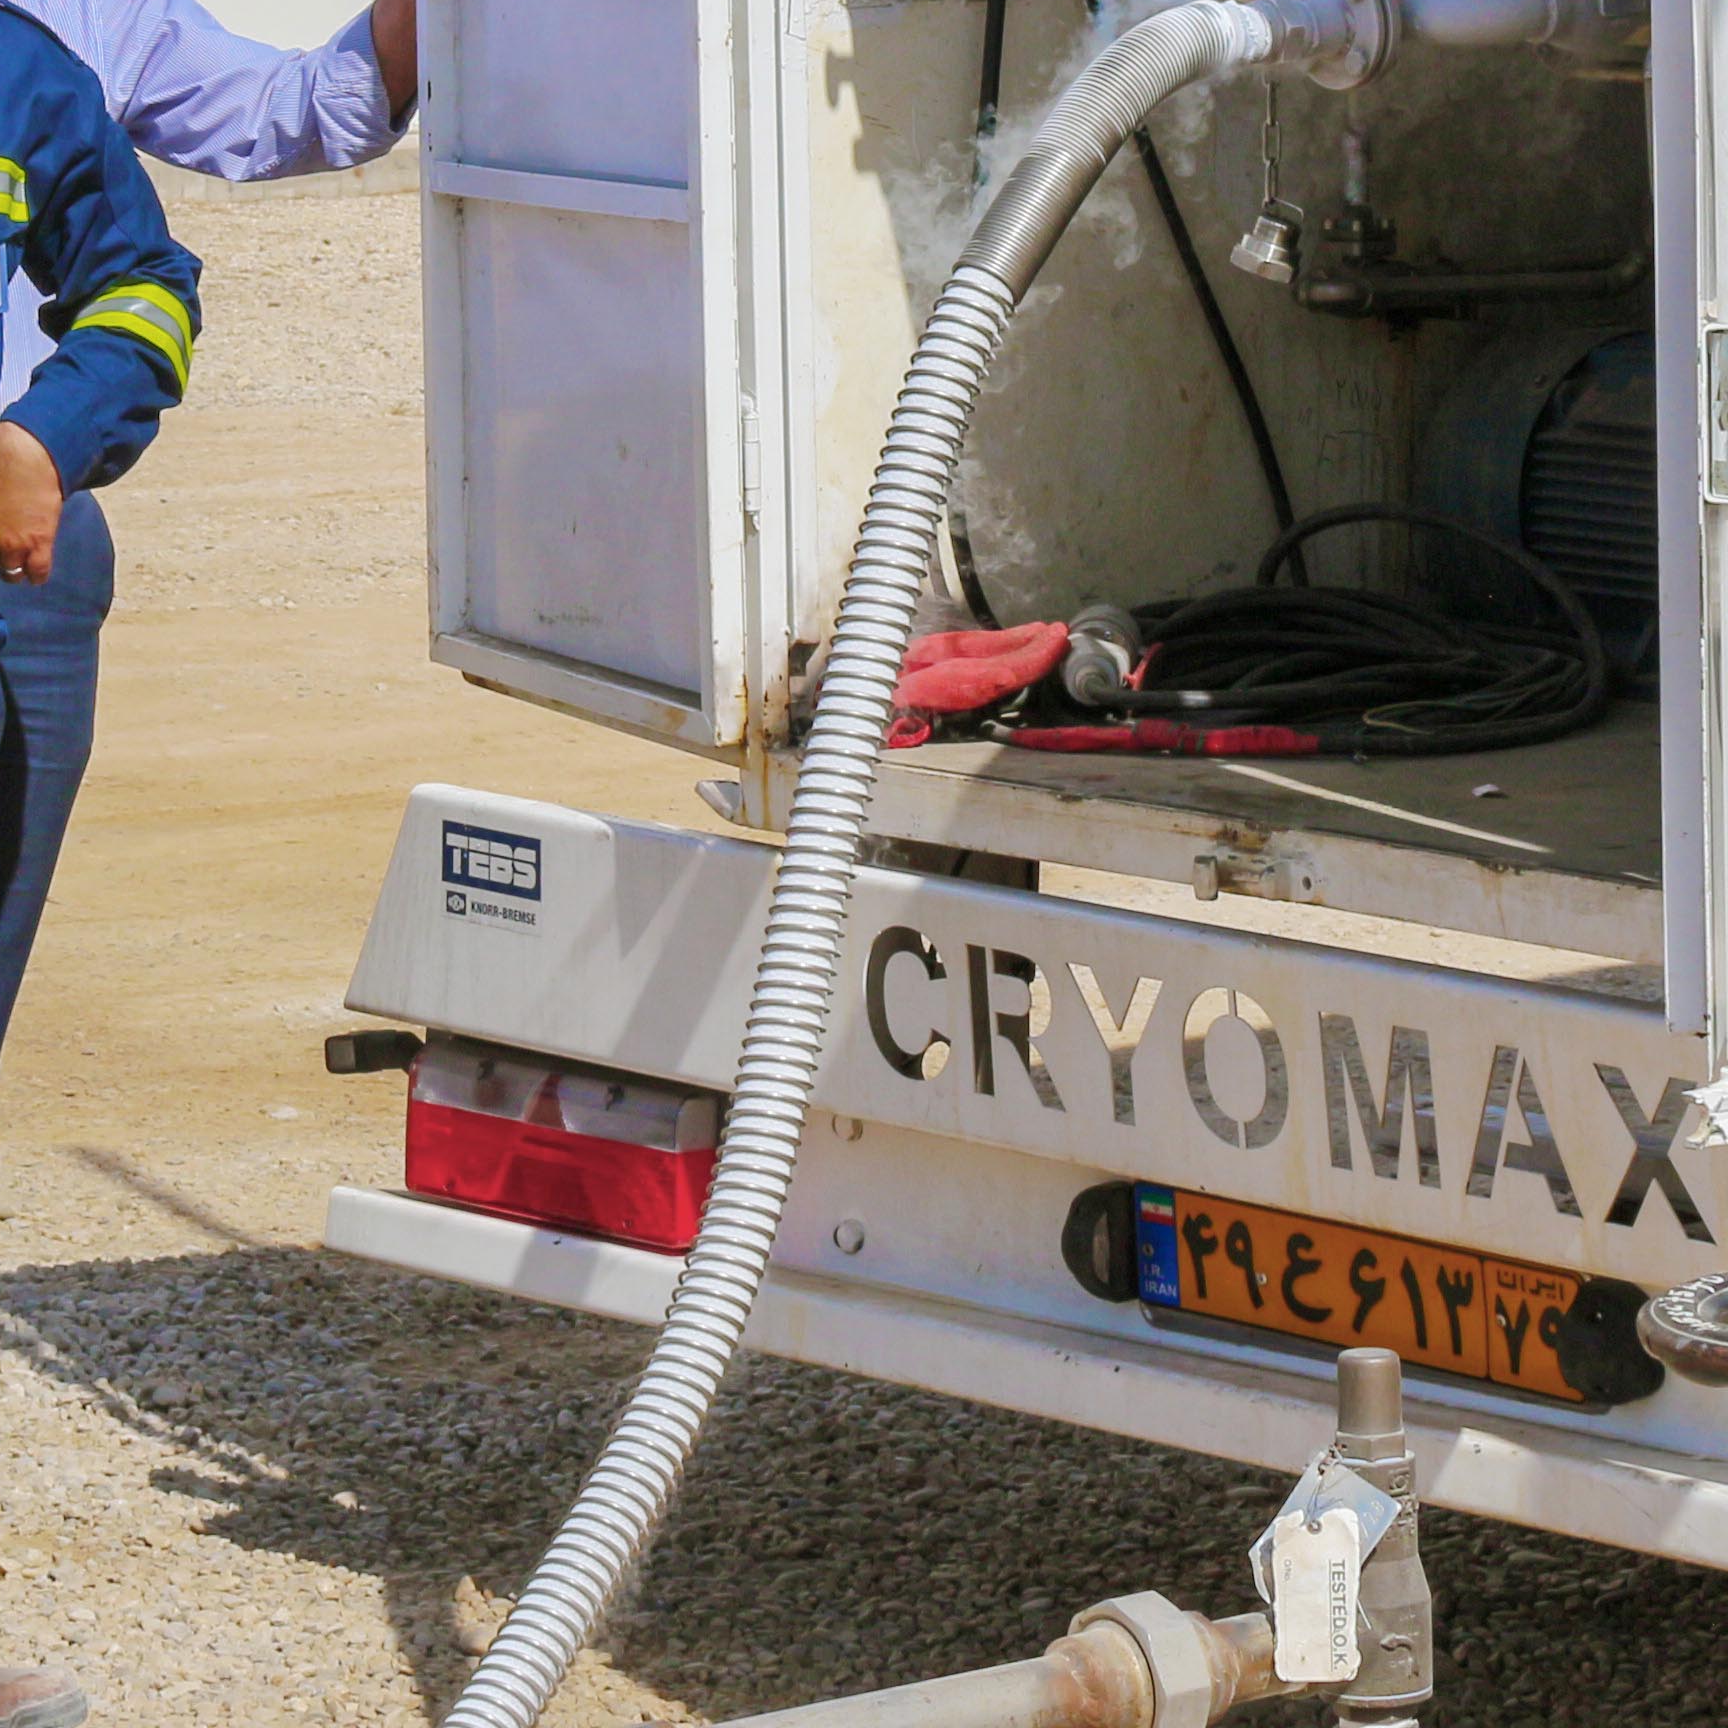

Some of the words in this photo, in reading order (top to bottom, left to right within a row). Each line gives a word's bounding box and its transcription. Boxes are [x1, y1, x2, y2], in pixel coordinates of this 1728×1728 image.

[445, 832, 537, 889] TEBS
[471, 902, 536, 925] KNORR-BREMSE
[866, 925, 1716, 1244] CRYOMAX
[1144, 1279, 1178, 1297] IRAN
[1331, 1559, 1348, 1630] TESTED
